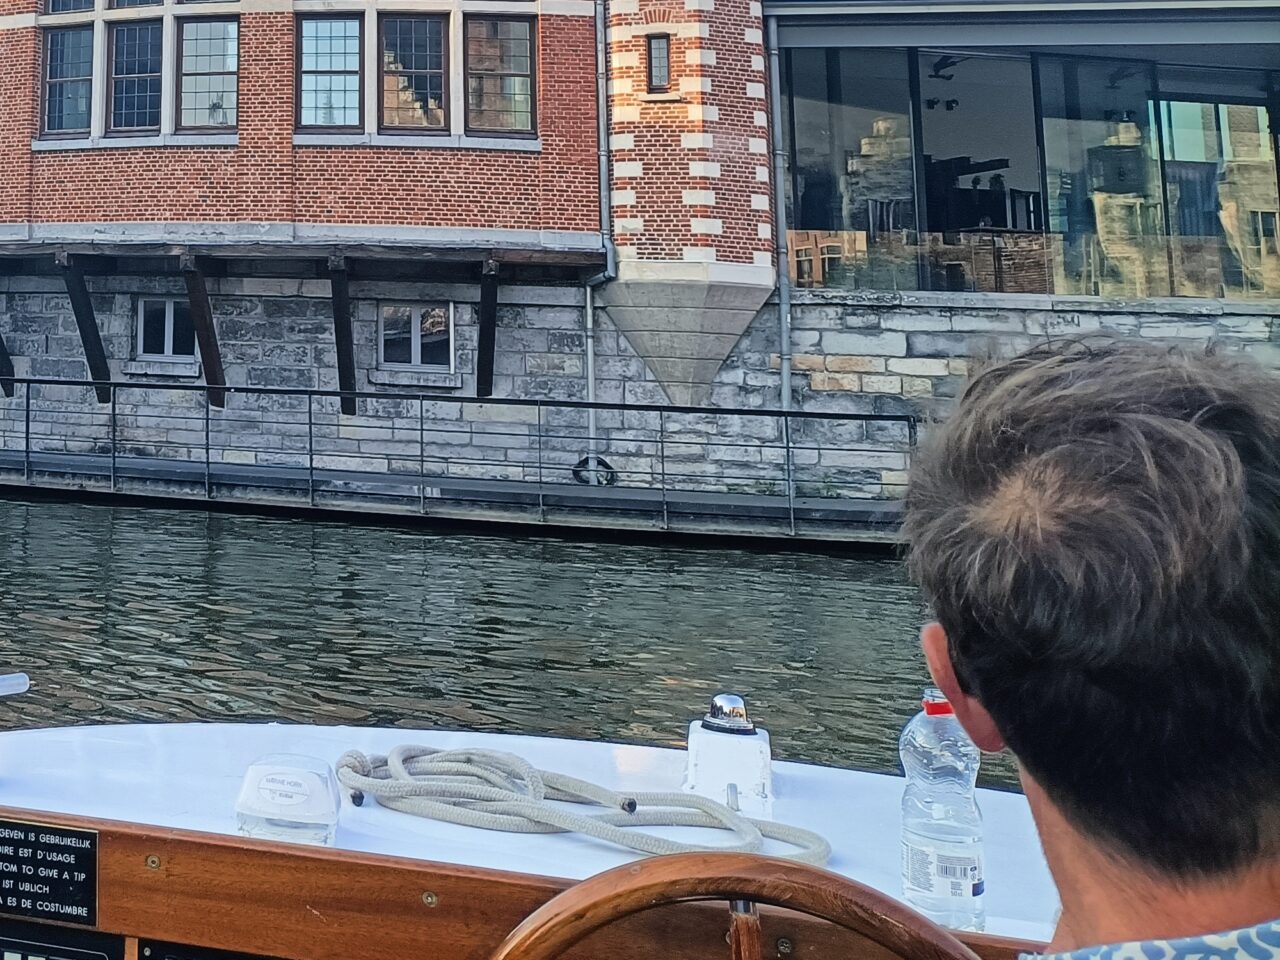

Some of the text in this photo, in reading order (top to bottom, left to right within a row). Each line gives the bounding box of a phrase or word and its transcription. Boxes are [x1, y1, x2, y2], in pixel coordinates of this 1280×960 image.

[28, 832, 36, 841] IS
[39, 833, 91, 849] GEBRUIKELIJK
[19, 848, 32, 858] EST
[37, 850, 76, 864] D'USAGE
[22, 865, 34, 875] TO
[38, 867, 58, 879] GIVE
[62, 871, 69, 880] A
[74, 872, 86, 882] TIP
[2, 879, 14, 889] IST
[18, 882, 49, 894] UBLICH
[7, 896, 17, 906] ES
[21, 899, 32, 909] DE
[36, 901, 88, 917] COSTUMBRE
